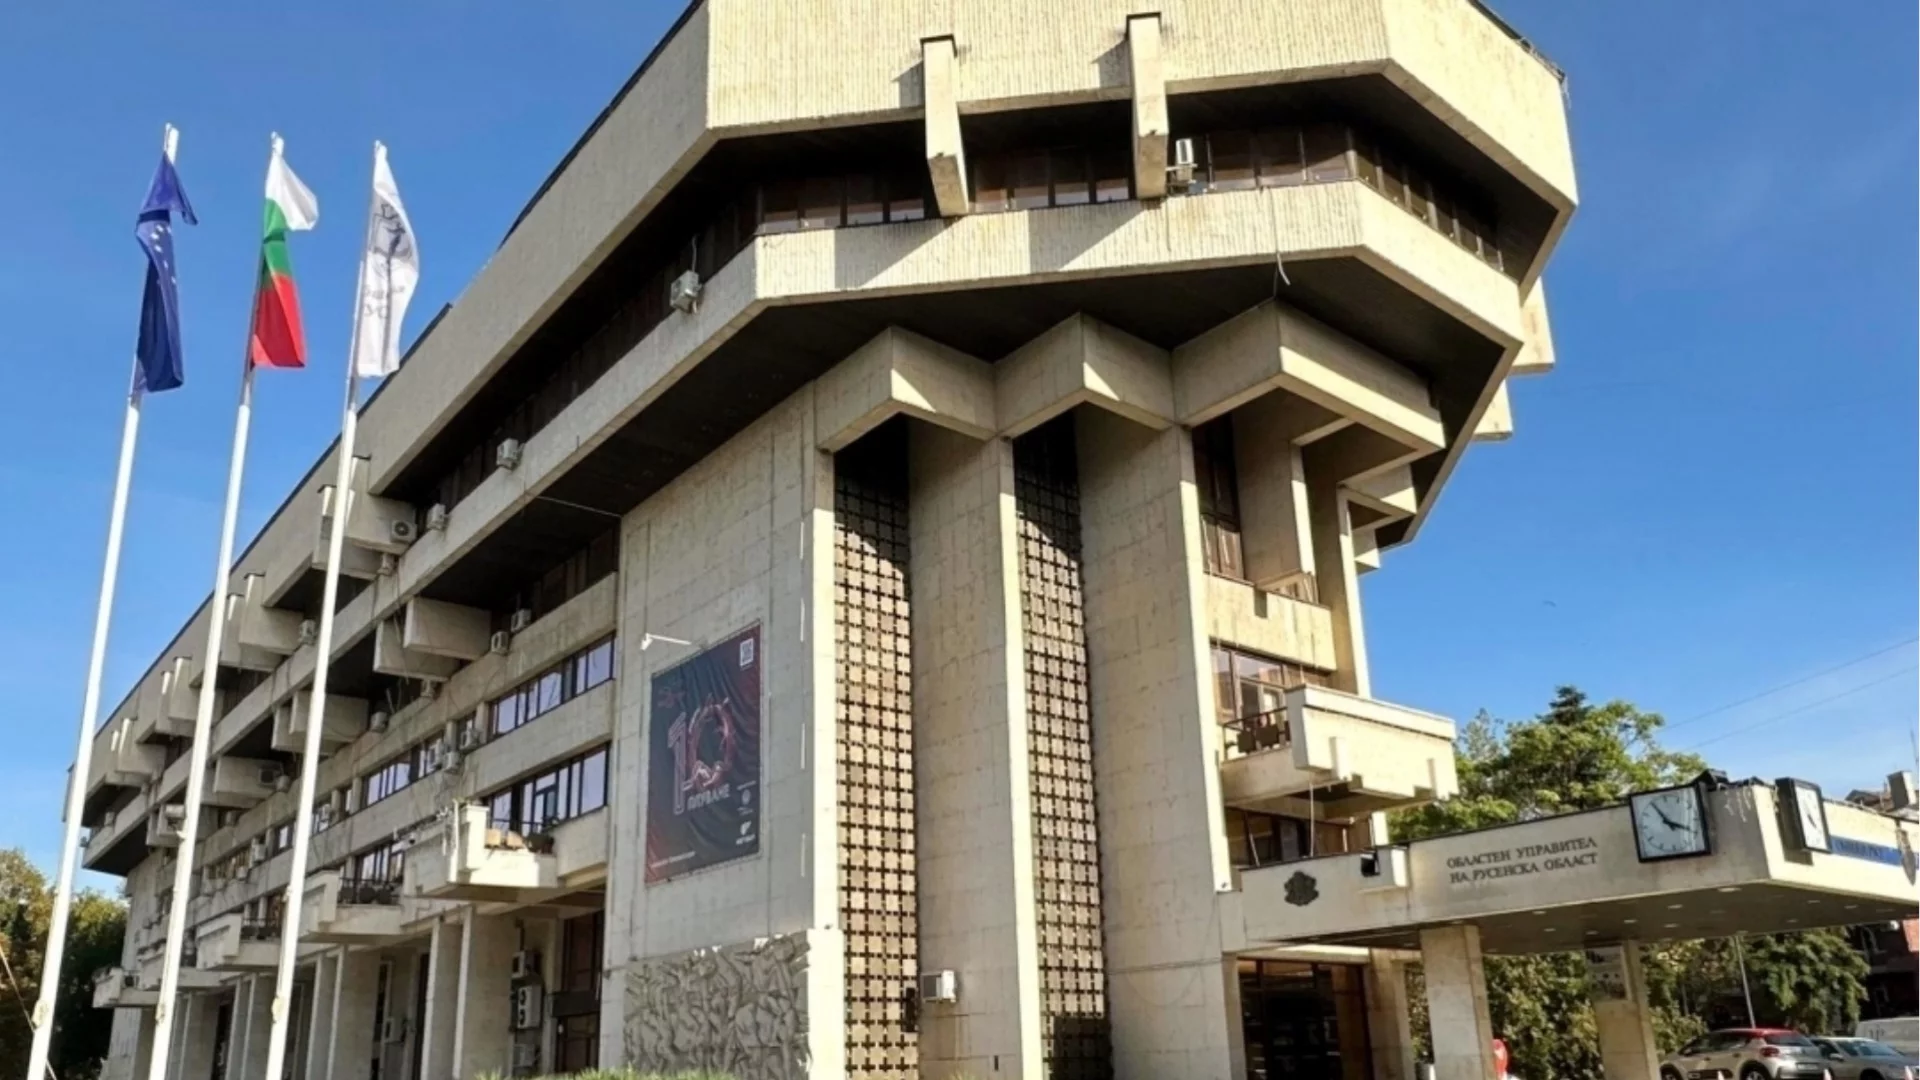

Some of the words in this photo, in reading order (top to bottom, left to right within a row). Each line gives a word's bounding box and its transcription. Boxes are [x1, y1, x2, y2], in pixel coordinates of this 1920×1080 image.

[1446, 849, 1511, 869] ОБЛАСТЕН
[1516, 836, 1598, 859] УПРАВИТЕЛ
[1449, 871, 1470, 884] НА
[1472, 862, 1539, 881] РУСЕНСКА
[1543, 852, 1598, 871] ОБЛАСТ
